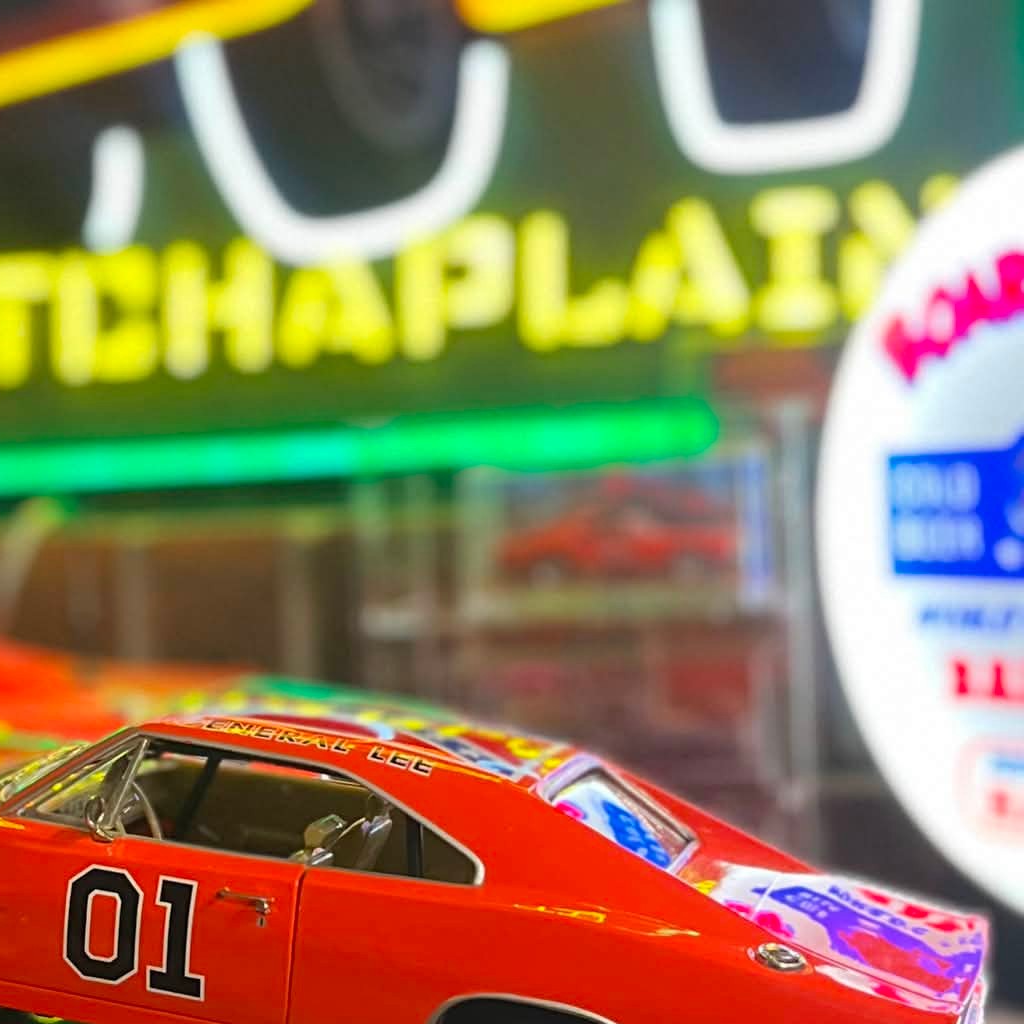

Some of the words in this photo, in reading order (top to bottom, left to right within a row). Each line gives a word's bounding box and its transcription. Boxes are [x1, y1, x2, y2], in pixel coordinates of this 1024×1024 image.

[188, 716, 353, 754] ENERAL
[366, 745, 436, 776] LEE
[62, 863, 206, 1002] 01
